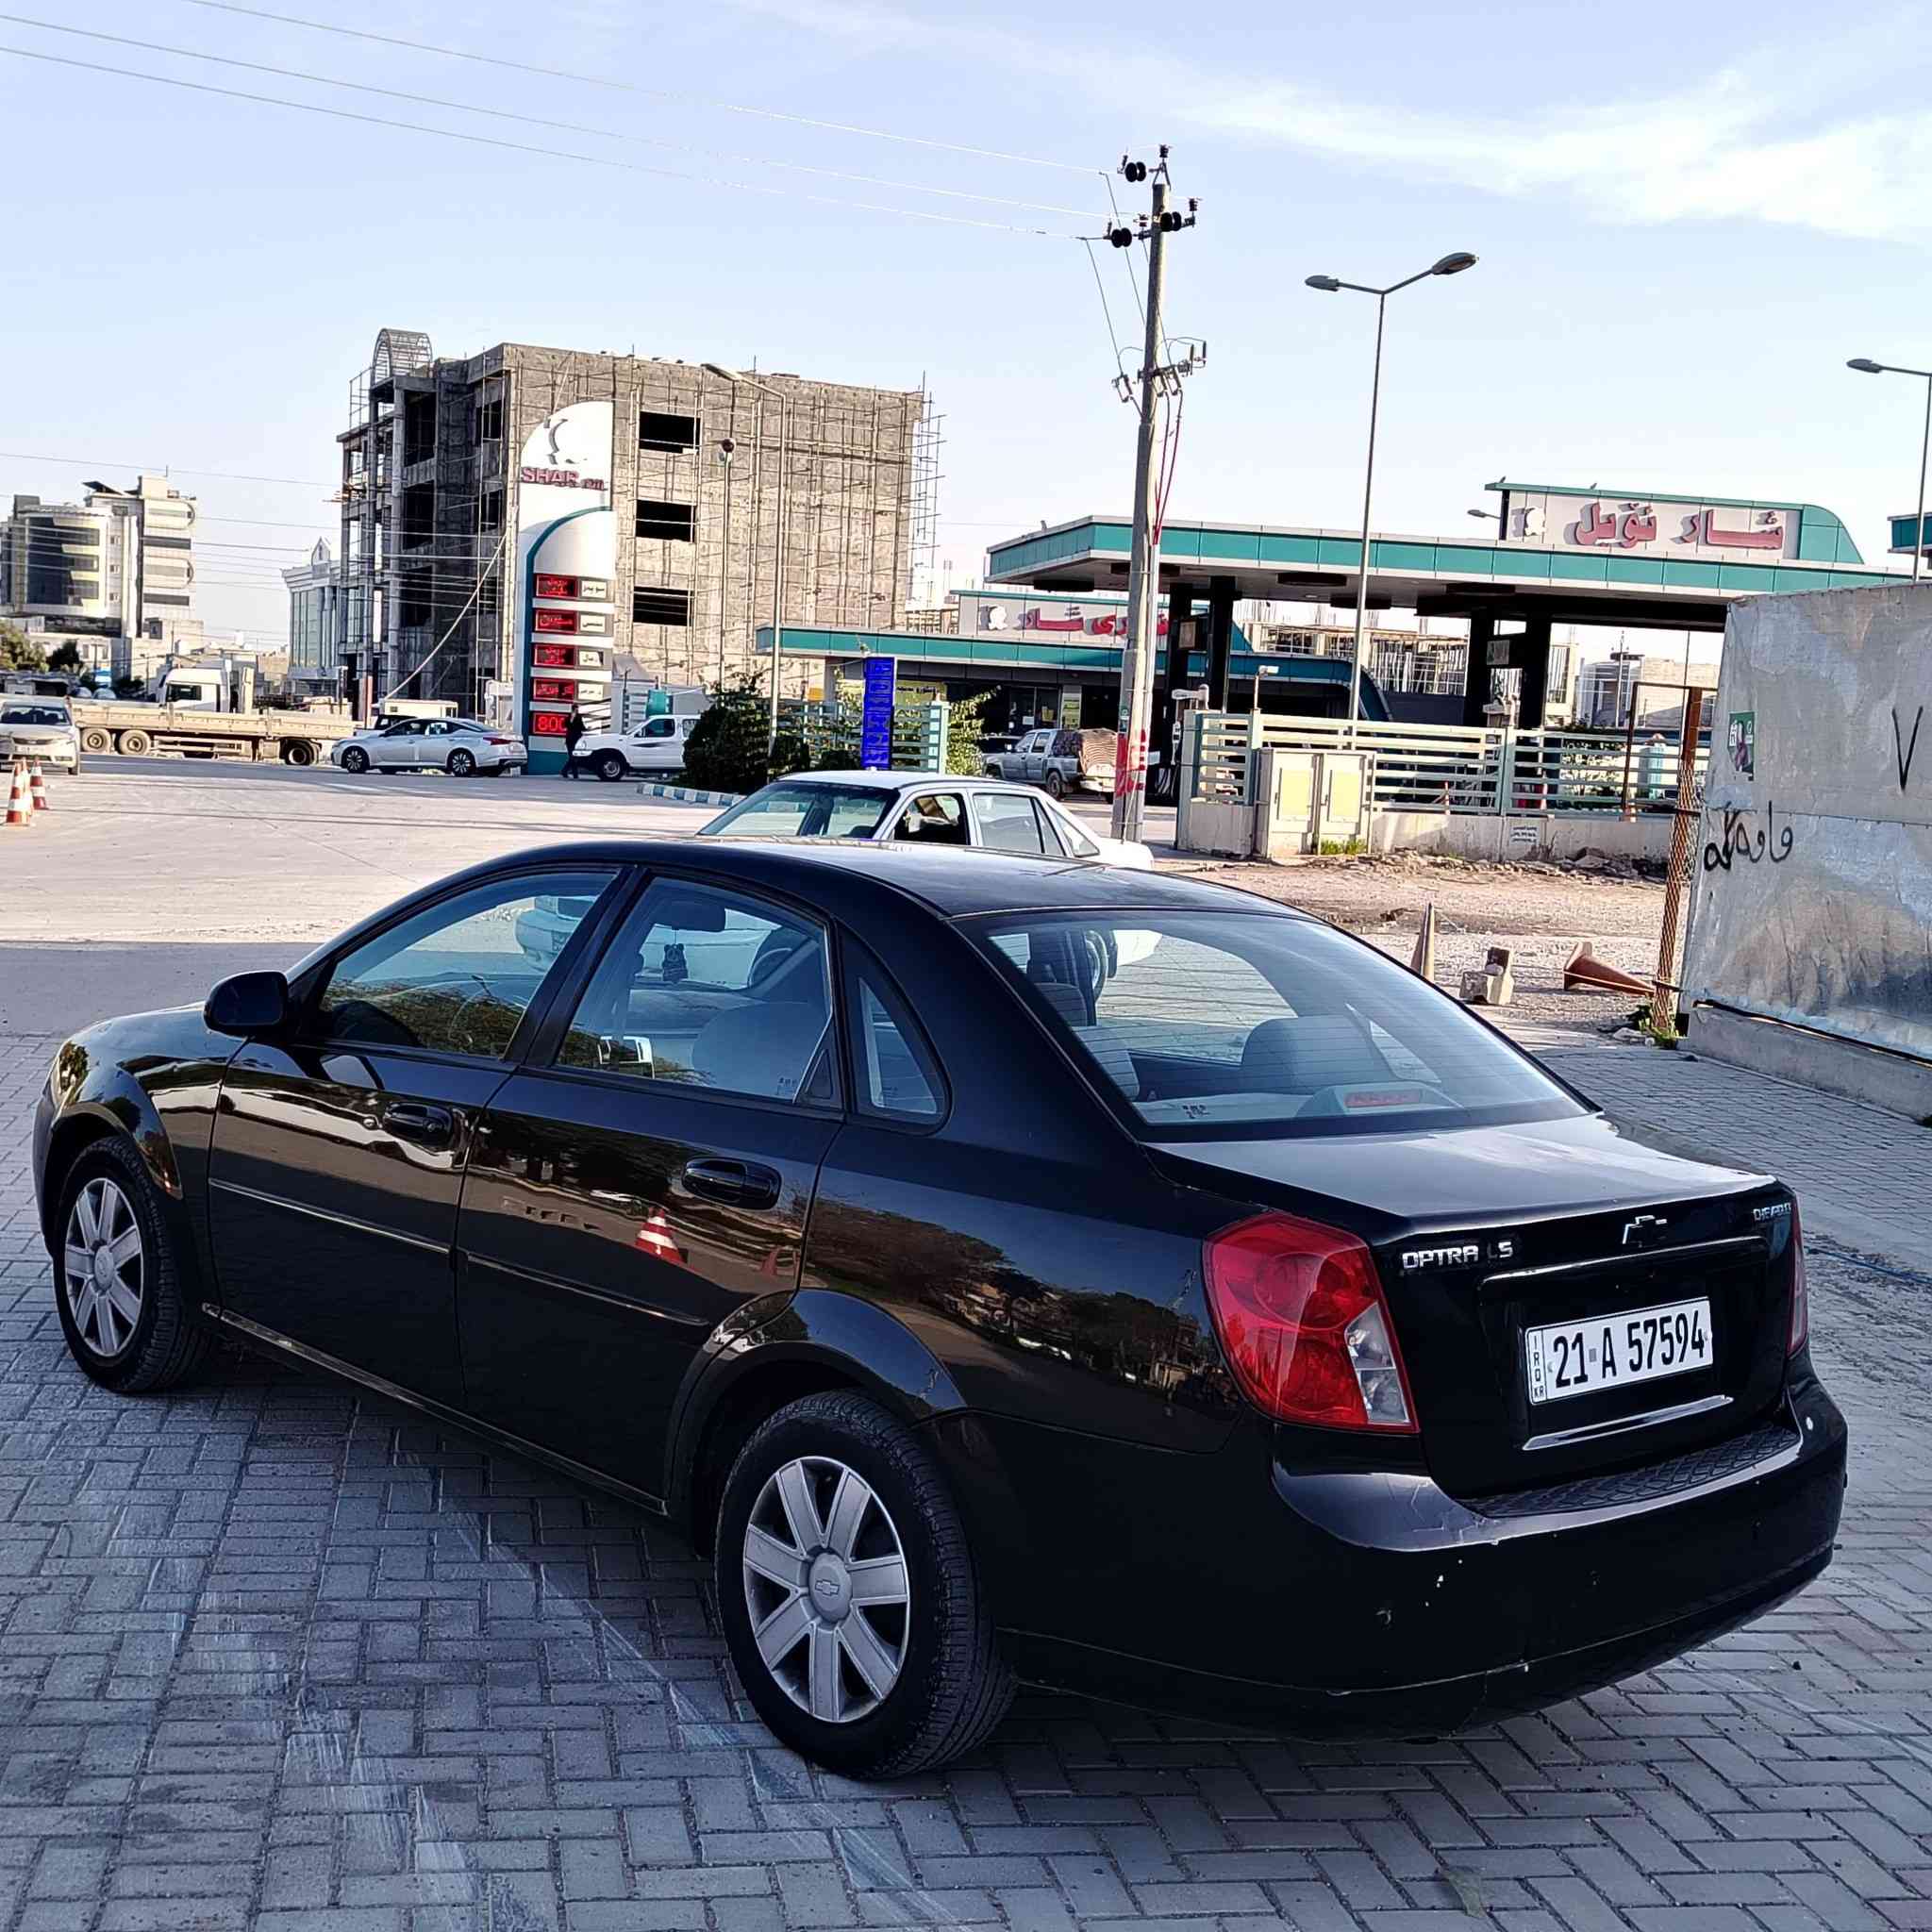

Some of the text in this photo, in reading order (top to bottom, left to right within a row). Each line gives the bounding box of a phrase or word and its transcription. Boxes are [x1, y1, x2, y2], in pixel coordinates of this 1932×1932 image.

[522, 467, 579, 486] SHAR
[1675, 509, 1783, 550] شار
[1402, 1244, 1479, 1269] OPTRA
[1553, 1309, 1705, 1389] 21 A 57594
